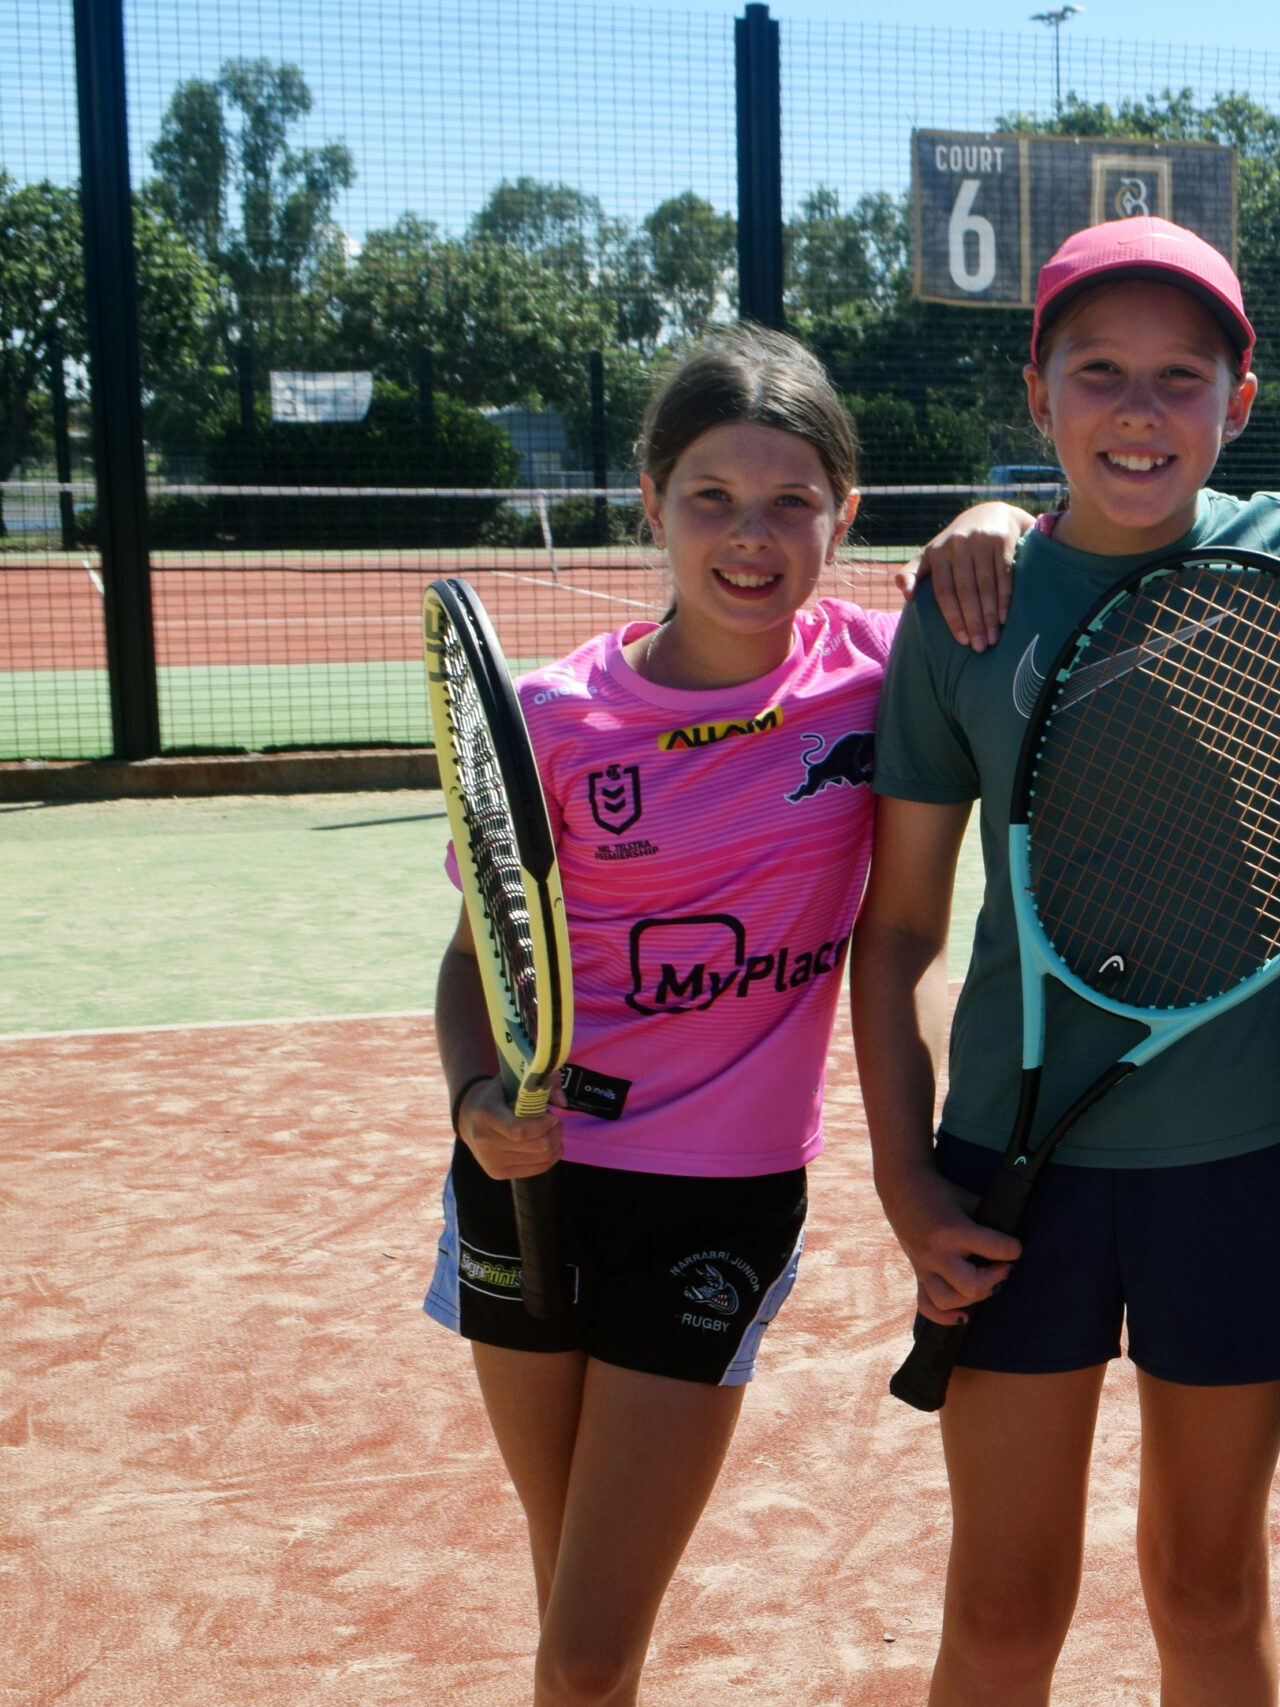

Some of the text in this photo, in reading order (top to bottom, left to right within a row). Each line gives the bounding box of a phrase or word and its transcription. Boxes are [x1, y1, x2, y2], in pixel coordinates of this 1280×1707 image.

[935, 145, 1004, 173] COURT
[949, 179, 996, 292] 6
[666, 711, 778, 750] ALLAM
[670, 1250, 761, 1294] NARRABRI JUNIOR
[681, 1313, 730, 1333] RUGBY
